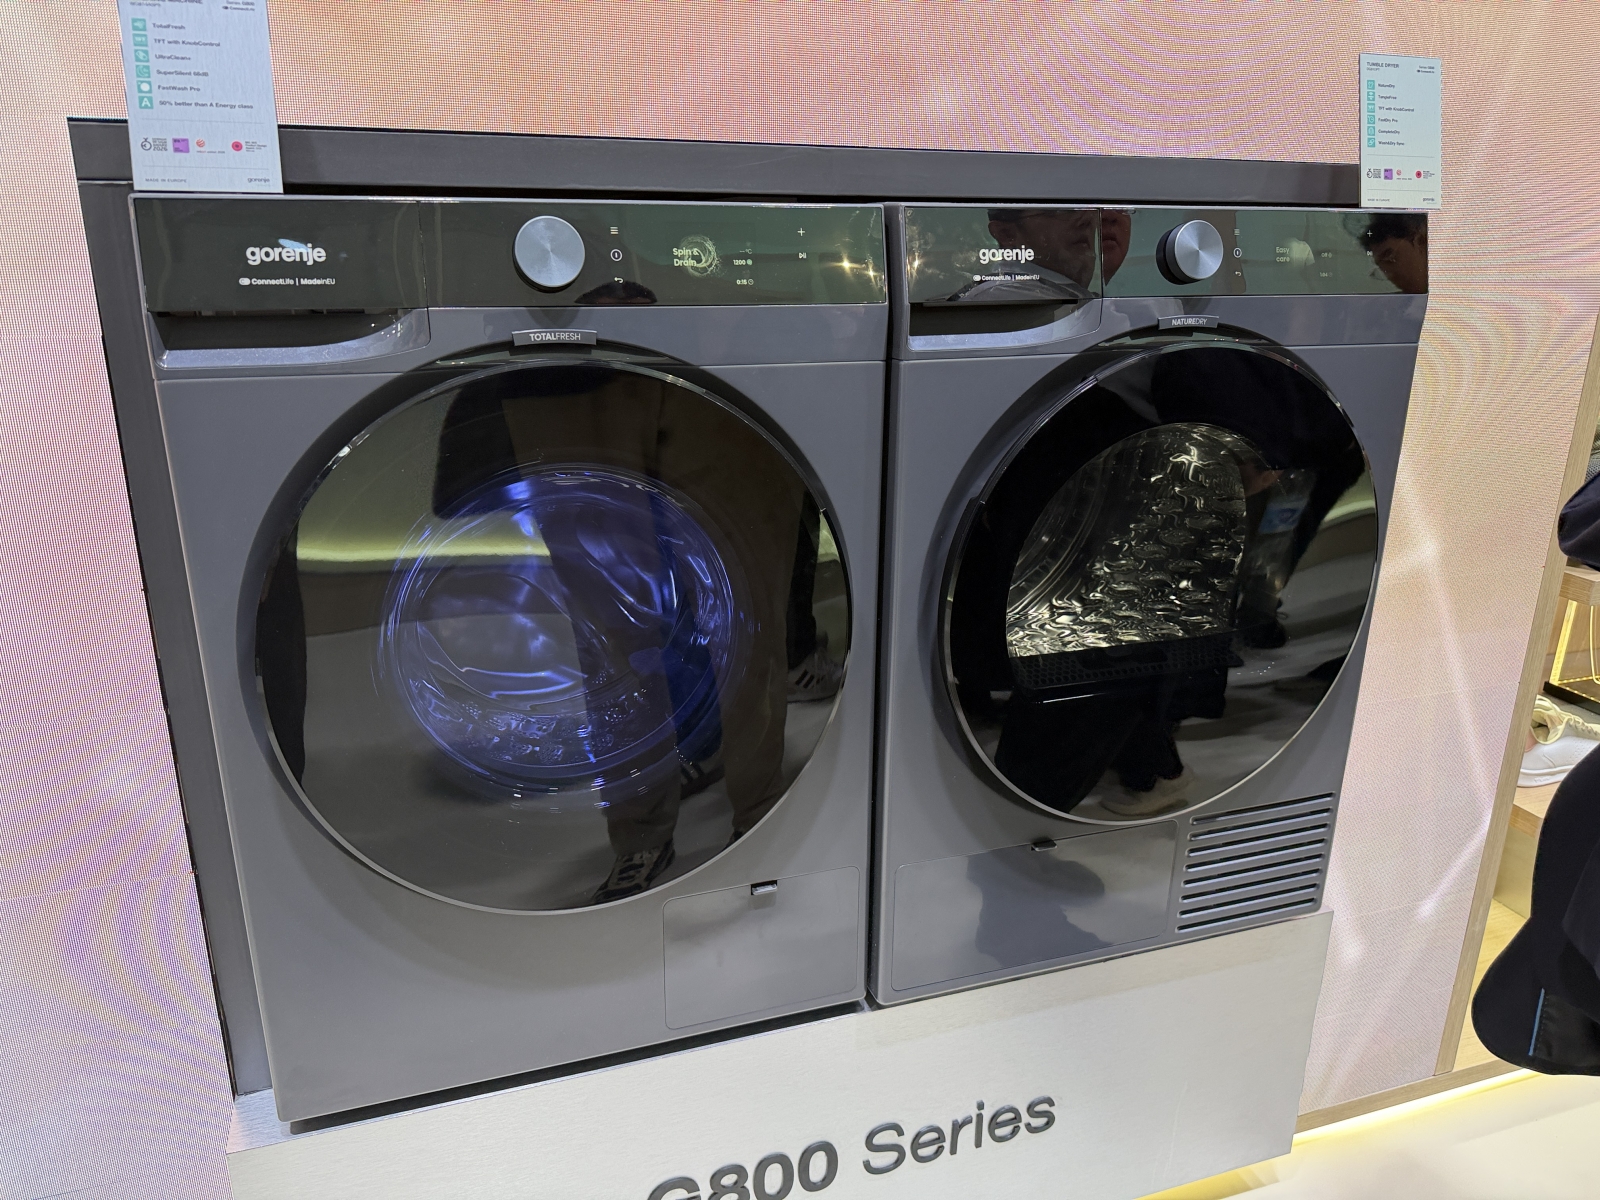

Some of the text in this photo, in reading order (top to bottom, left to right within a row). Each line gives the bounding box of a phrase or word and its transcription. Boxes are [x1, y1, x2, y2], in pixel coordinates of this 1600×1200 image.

[246, 243, 326, 266] gorenje
[673, 247, 691, 257] Spin
[979, 245, 1034, 264] gorenje
[1276, 246, 1290, 254] Easy
[674, 258, 697, 266] Drain
[529, 333, 581, 341] TOTALFRESH
[862, 1094, 1056, 1175] Series
